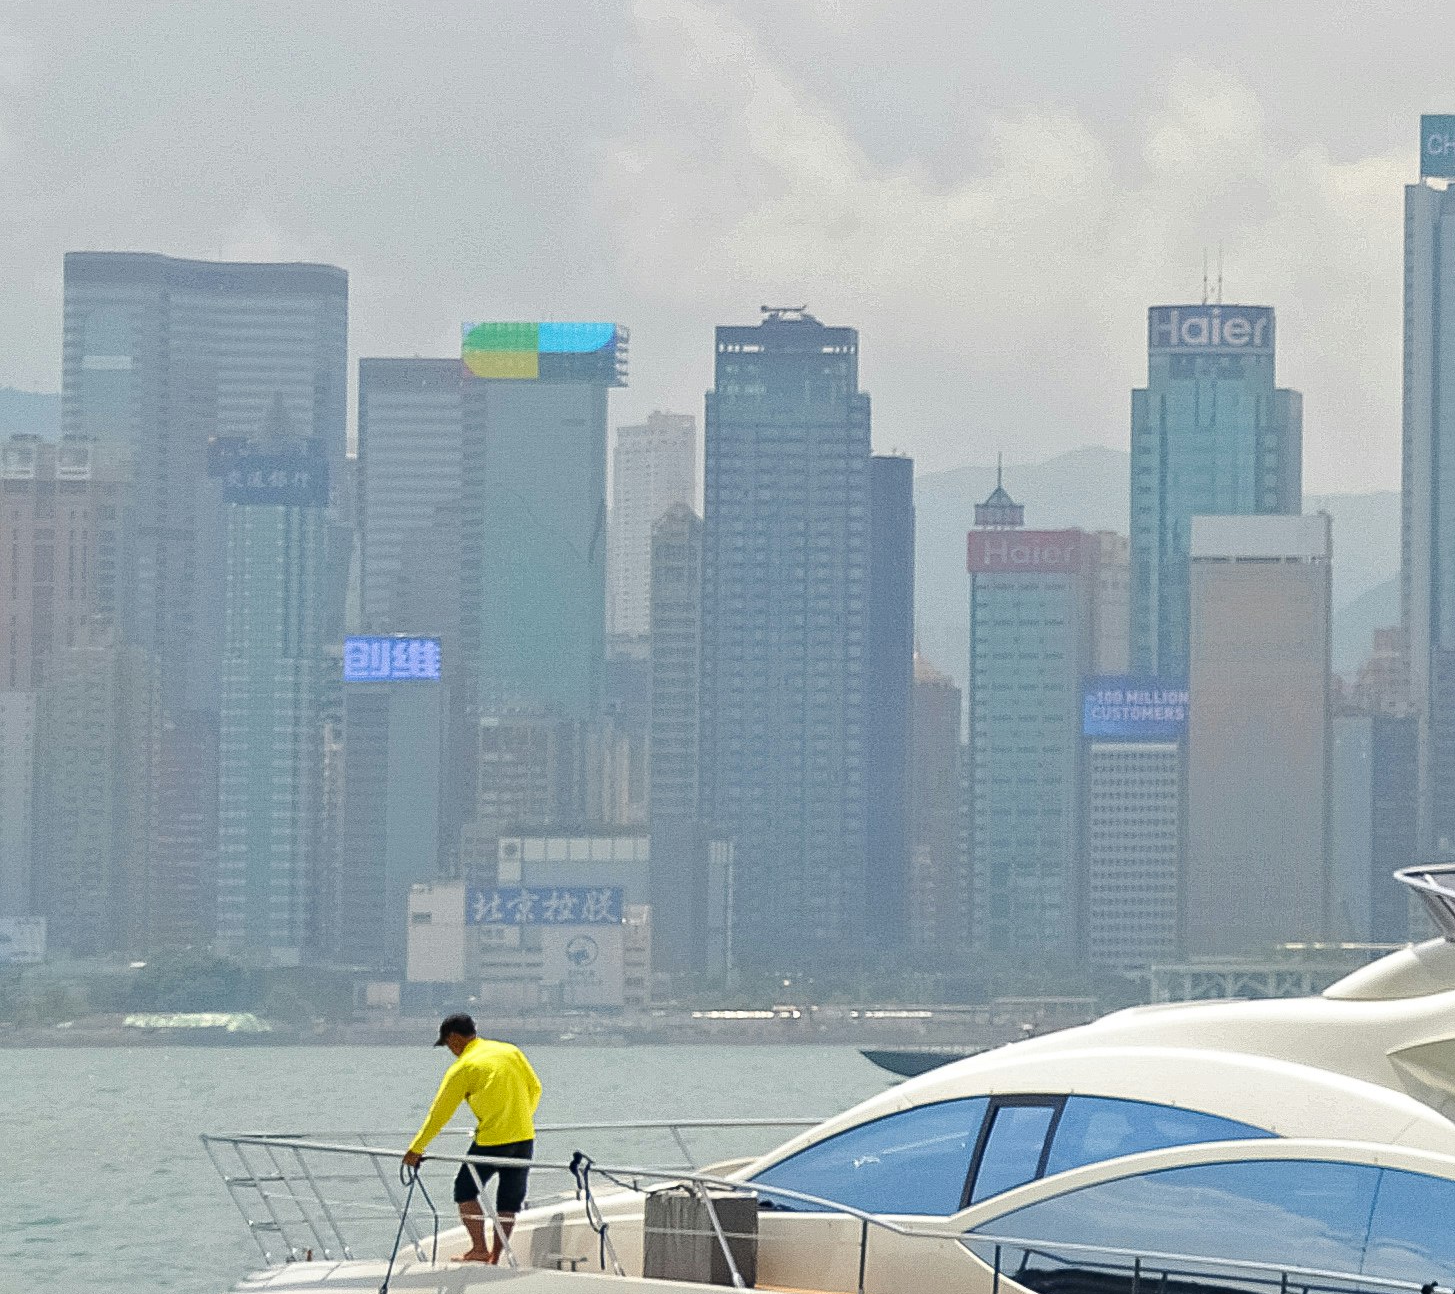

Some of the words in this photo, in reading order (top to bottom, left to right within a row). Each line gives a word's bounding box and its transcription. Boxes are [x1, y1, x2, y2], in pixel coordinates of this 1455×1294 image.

[1151, 307, 1268, 347] Haier
[983, 539, 1075, 565] Haier
[1091, 705, 1185, 721] CUSTOMERS
